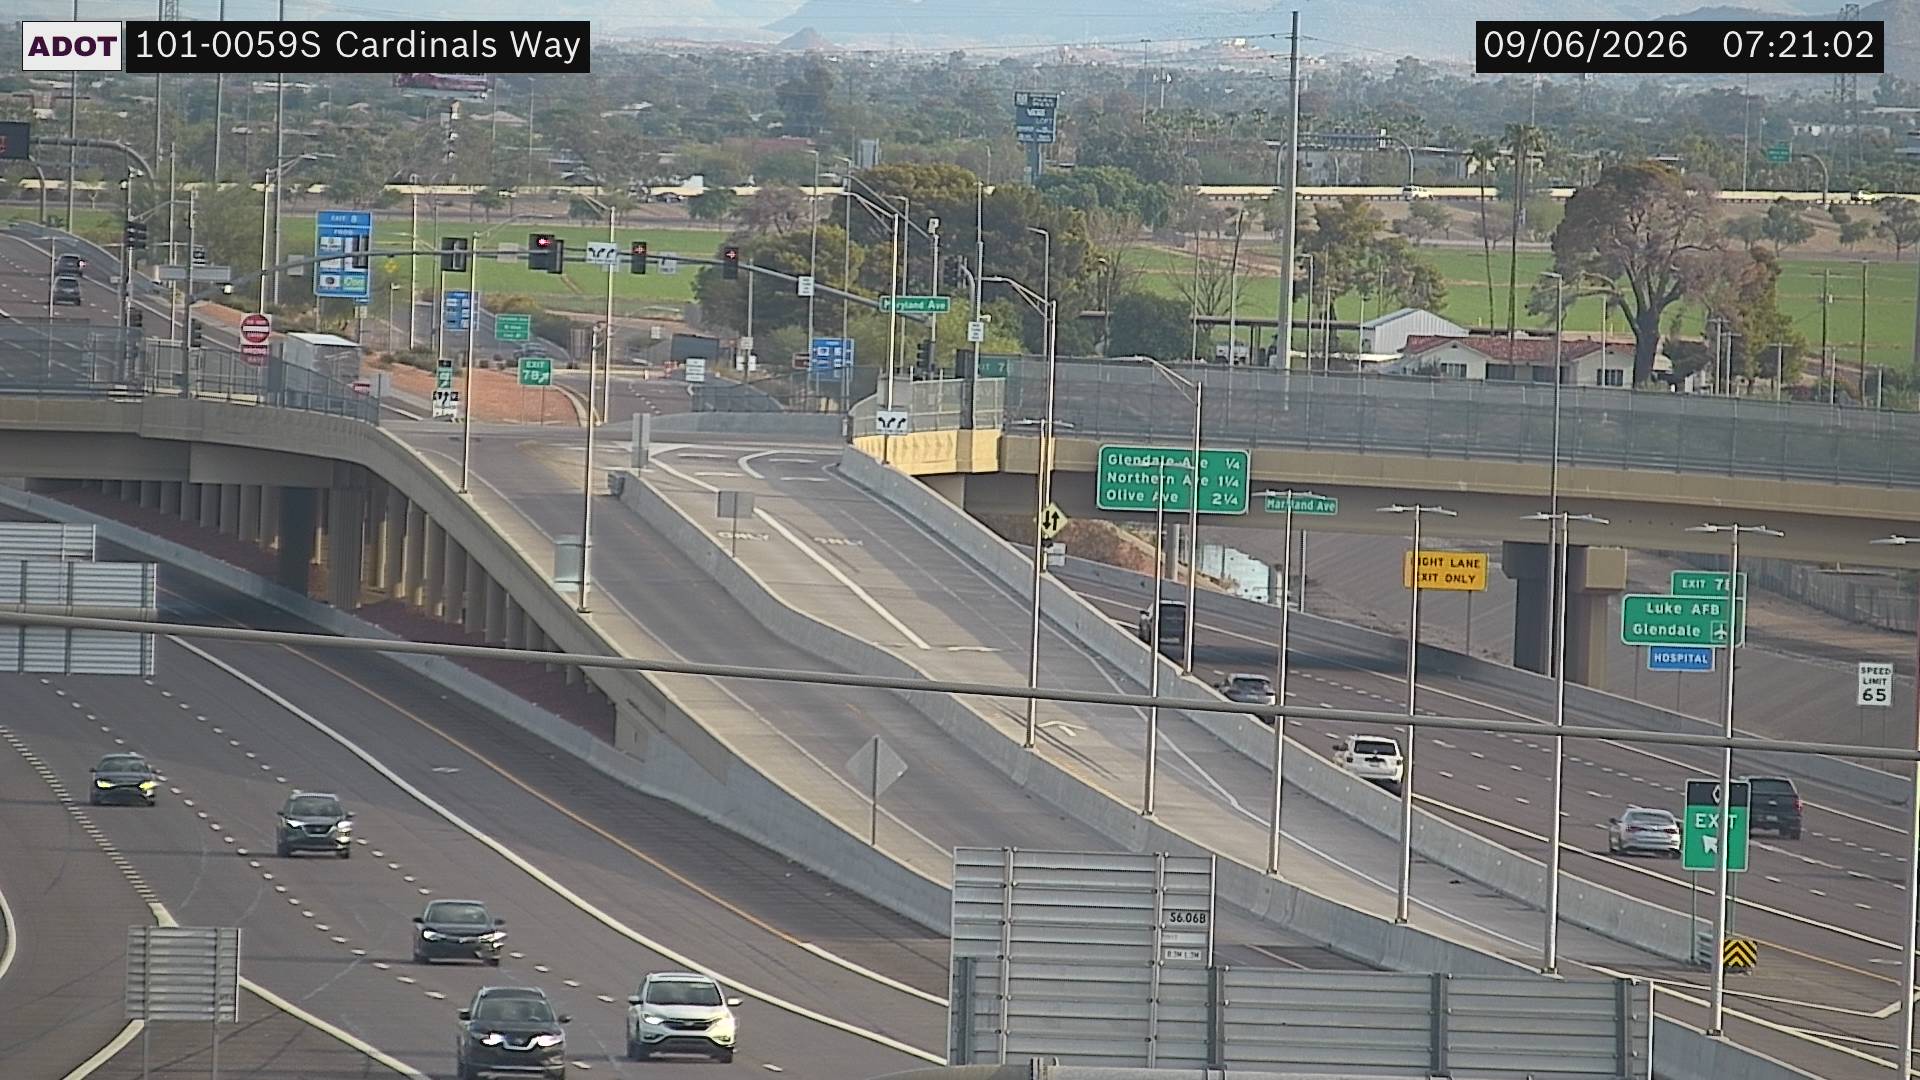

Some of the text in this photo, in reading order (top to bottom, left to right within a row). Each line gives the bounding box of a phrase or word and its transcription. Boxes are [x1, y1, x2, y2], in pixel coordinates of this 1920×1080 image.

[883, 299, 946, 312] Mryland Ave
[525, 360, 545, 369] EXIT
[1108, 453, 1175, 466] Glendale
[1182, 456, 1209, 470] Ae
[1107, 471, 1175, 486] Northern
[1182, 474, 1209, 488] Ae
[1106, 489, 1144, 501] Olive
[1152, 491, 1179, 503] Ave
[1267, 499, 1336, 512] Marland Ave
[1450, 558, 1480, 569] LANE
[1444, 572, 1475, 584] ONLY
[1682, 578, 1706, 589] EXIT
[1646, 601, 1720, 616] Luke AFB
[1633, 622, 1701, 637] Glendale
[1654, 652, 1708, 665] HOSPITAL
[1861, 666, 1891, 675] SPEED
[1863, 677, 1887, 685] LIMIT
[1862, 687, 1887, 702] 65
[1695, 813, 1738, 830] EXT
